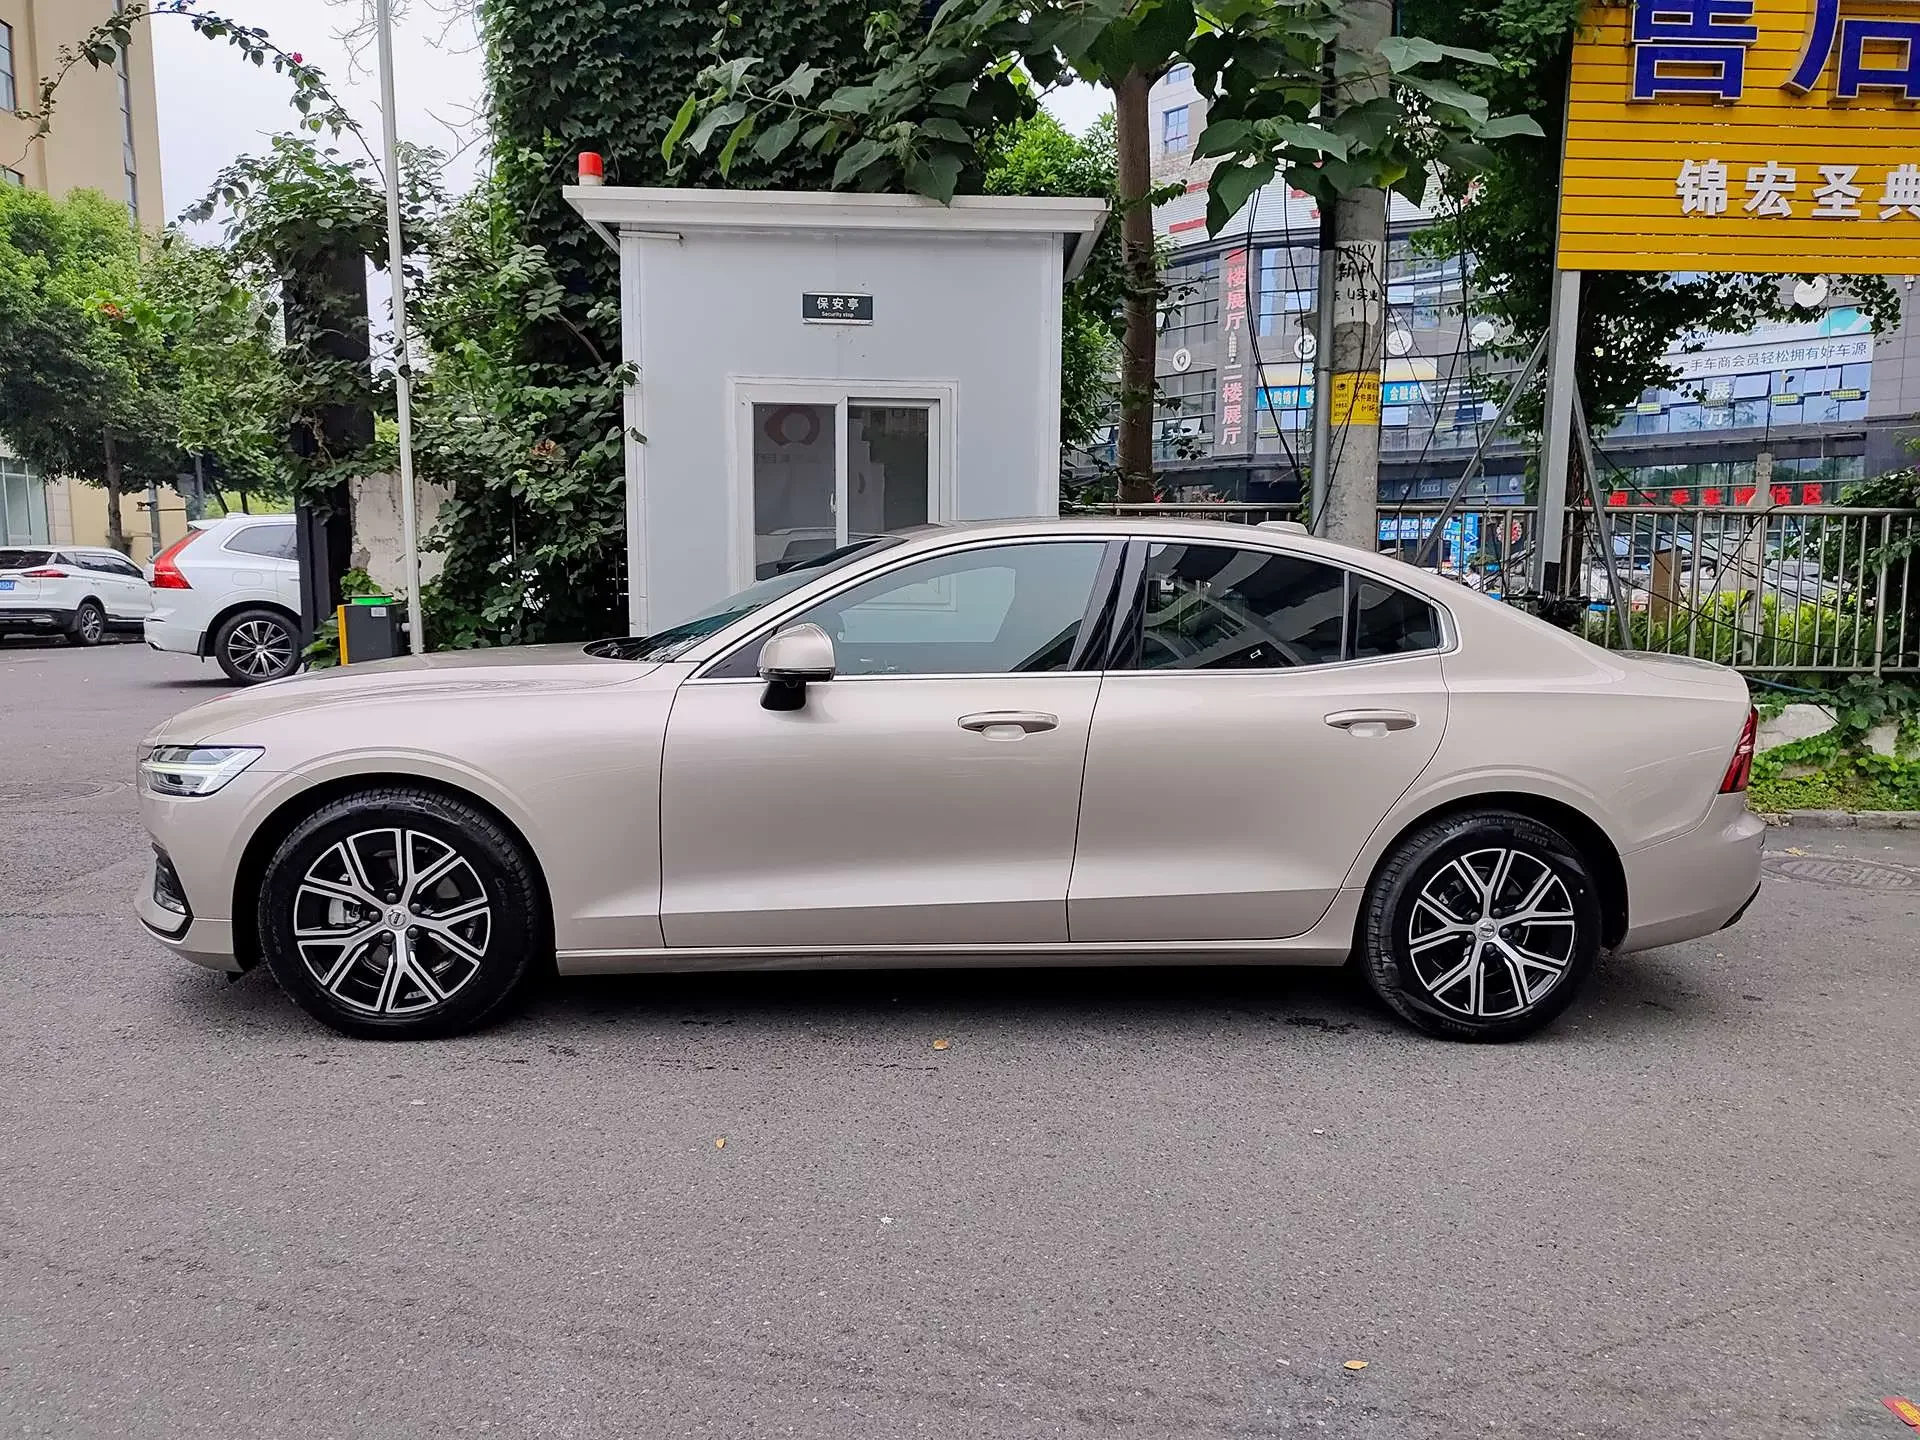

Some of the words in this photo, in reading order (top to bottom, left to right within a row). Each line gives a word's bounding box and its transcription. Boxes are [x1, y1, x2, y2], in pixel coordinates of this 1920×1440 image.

[1675, 159, 1920, 220] 锦宏圣典
[816, 297, 859, 310] 保安亭
[1669, 340, 1868, 373] 二手车商会员轻松拥有好车源
